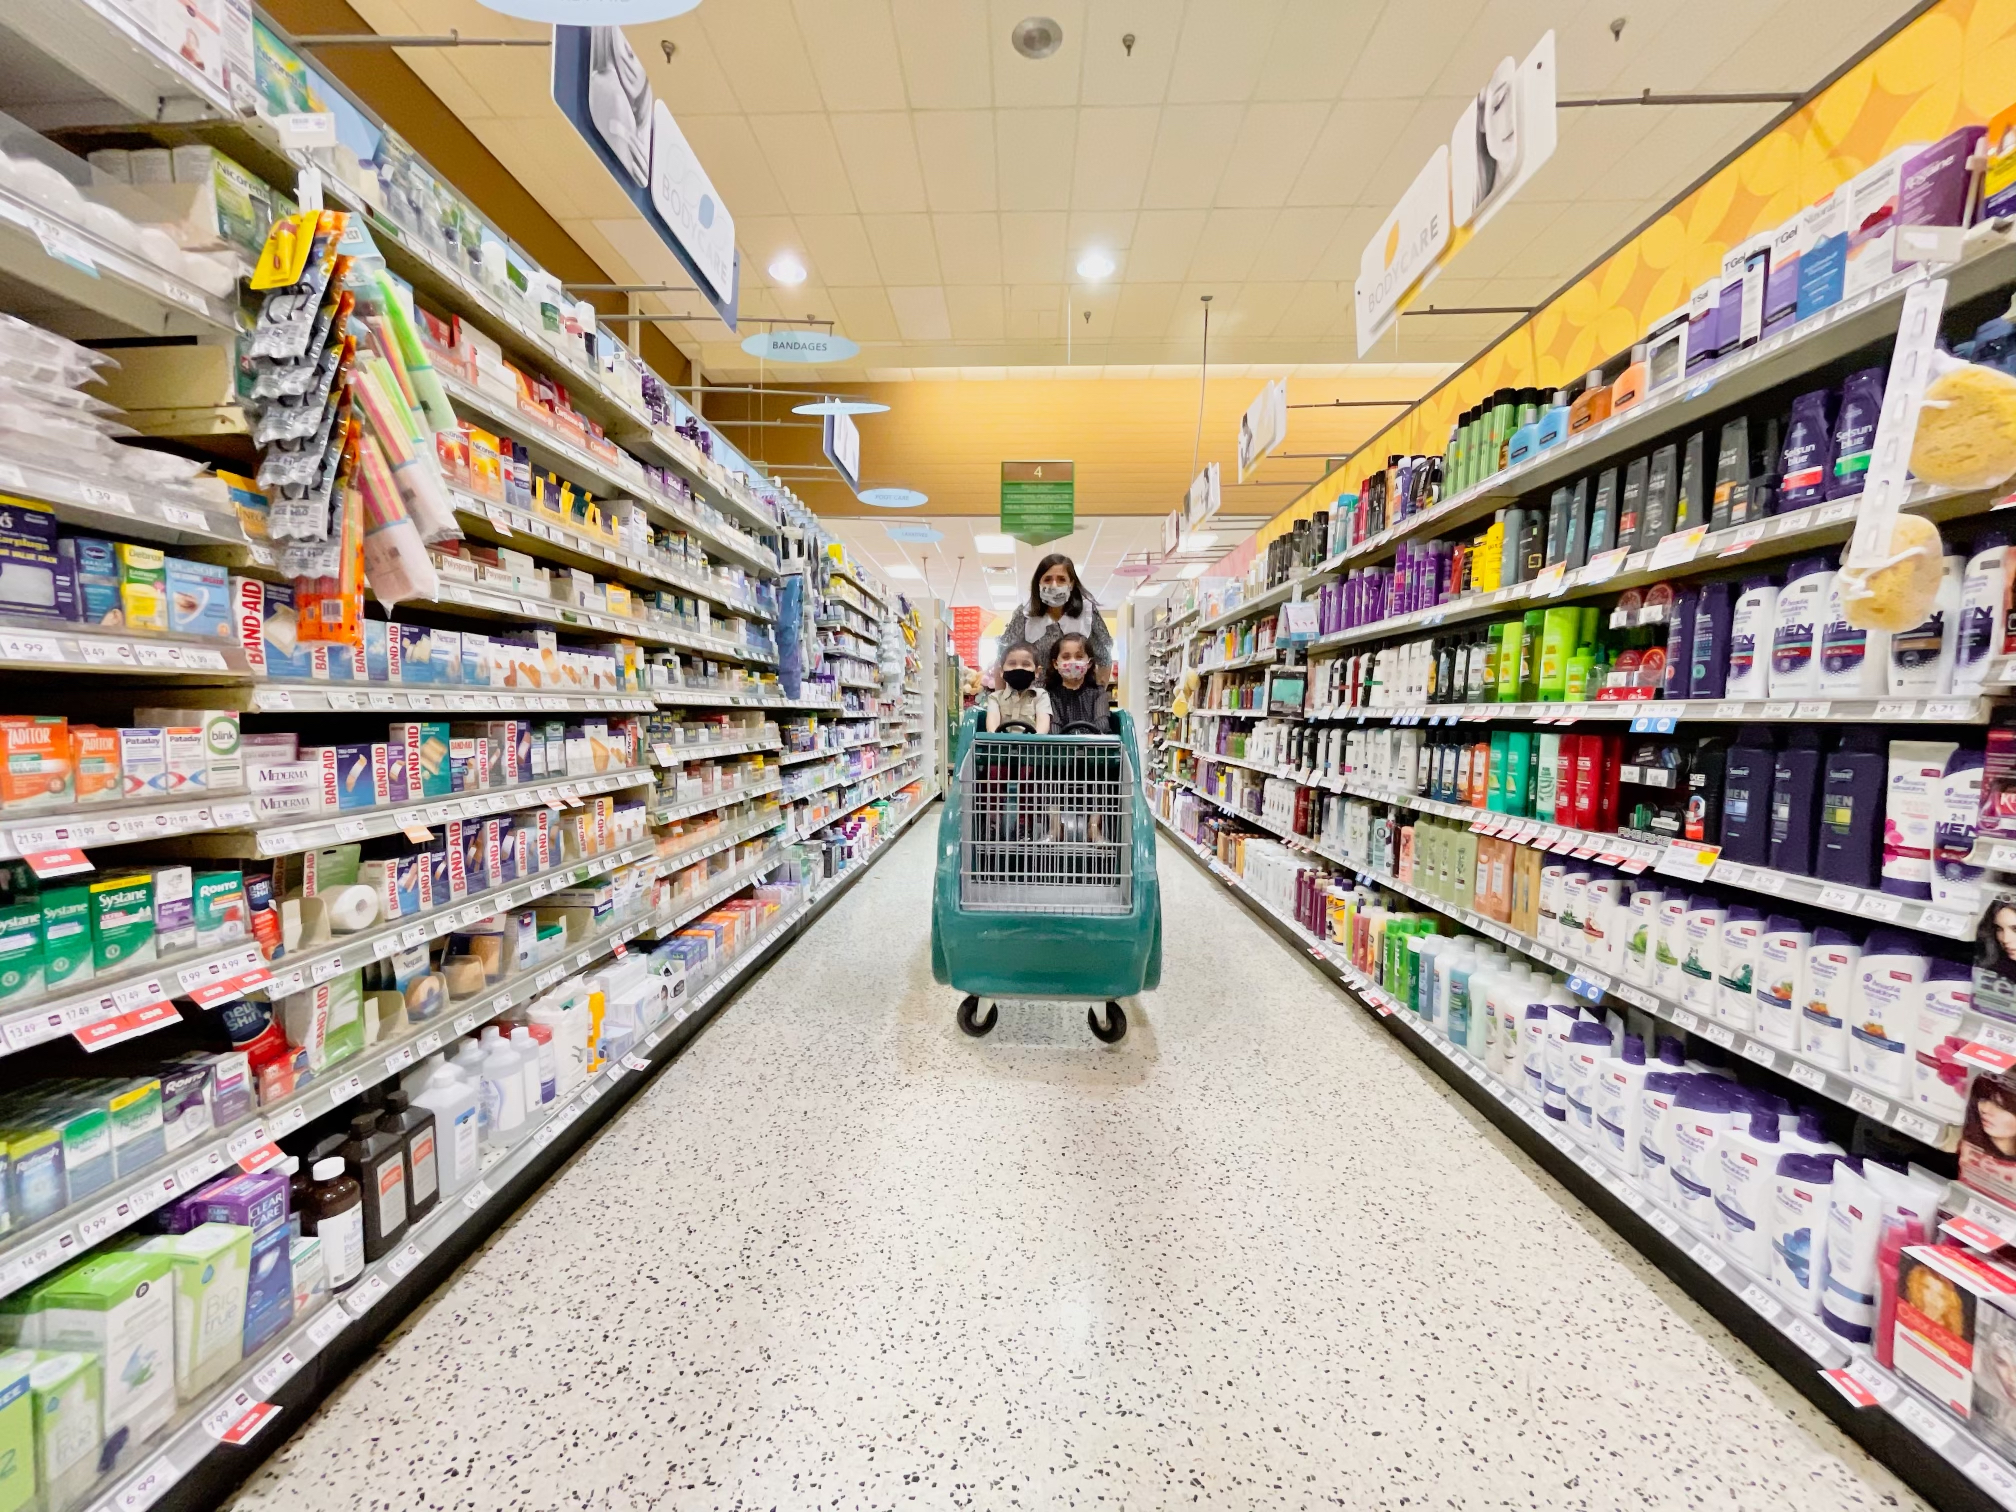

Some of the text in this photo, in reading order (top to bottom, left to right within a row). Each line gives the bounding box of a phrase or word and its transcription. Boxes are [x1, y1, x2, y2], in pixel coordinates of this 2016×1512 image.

[772, 341, 828, 352] BANDAGES
[1836, 424, 1872, 441] Selsun
[1840, 436, 1864, 449] blue
[1784, 443, 1816, 459] Selsun
[1787, 454, 1809, 467] blue
[1034, 466, 1042, 478] 4
[242, 581, 264, 665] BAND-AID
[1774, 622, 1814, 638] MEN
[389, 625, 400, 675] BAND-AID
[8, 728, 51, 749] ZADITOR
[82, 737, 114, 752] ZADITOR
[125, 737, 160, 748] Pataday
[170, 735, 201, 746] Pataday
[212, 730, 235, 742] blink
[451, 741, 472, 749] BAND-AID
[408, 725, 421, 791] BAND-AID
[508, 722, 517, 779] BAND-AID
[375, 747, 387, 797] BAND-AID
[480, 740, 488, 783] BAND-AID
[259, 769, 308, 783] MEDERMA
[323, 750, 336, 805] BAND-AID
[260, 797, 310, 811] MEDERMA
[1826, 794, 1852, 806] MEN
[538, 812, 548, 864] BAND-AID
[451, 822, 465, 892] BAND-AID
[488, 821, 500, 879] BAND-AID
[519, 831, 527, 871] BAND-AID
[386, 862, 399, 911] BAND-AID
[421, 856, 432, 903] BAND-AID
[98, 888, 147, 912] Systane
[44, 902, 88, 922] Systane
[316, 986, 328, 1049] BAND-AID
[251, 1192, 282, 1218] CLEAR
[253, 1207, 281, 1228] CARE
